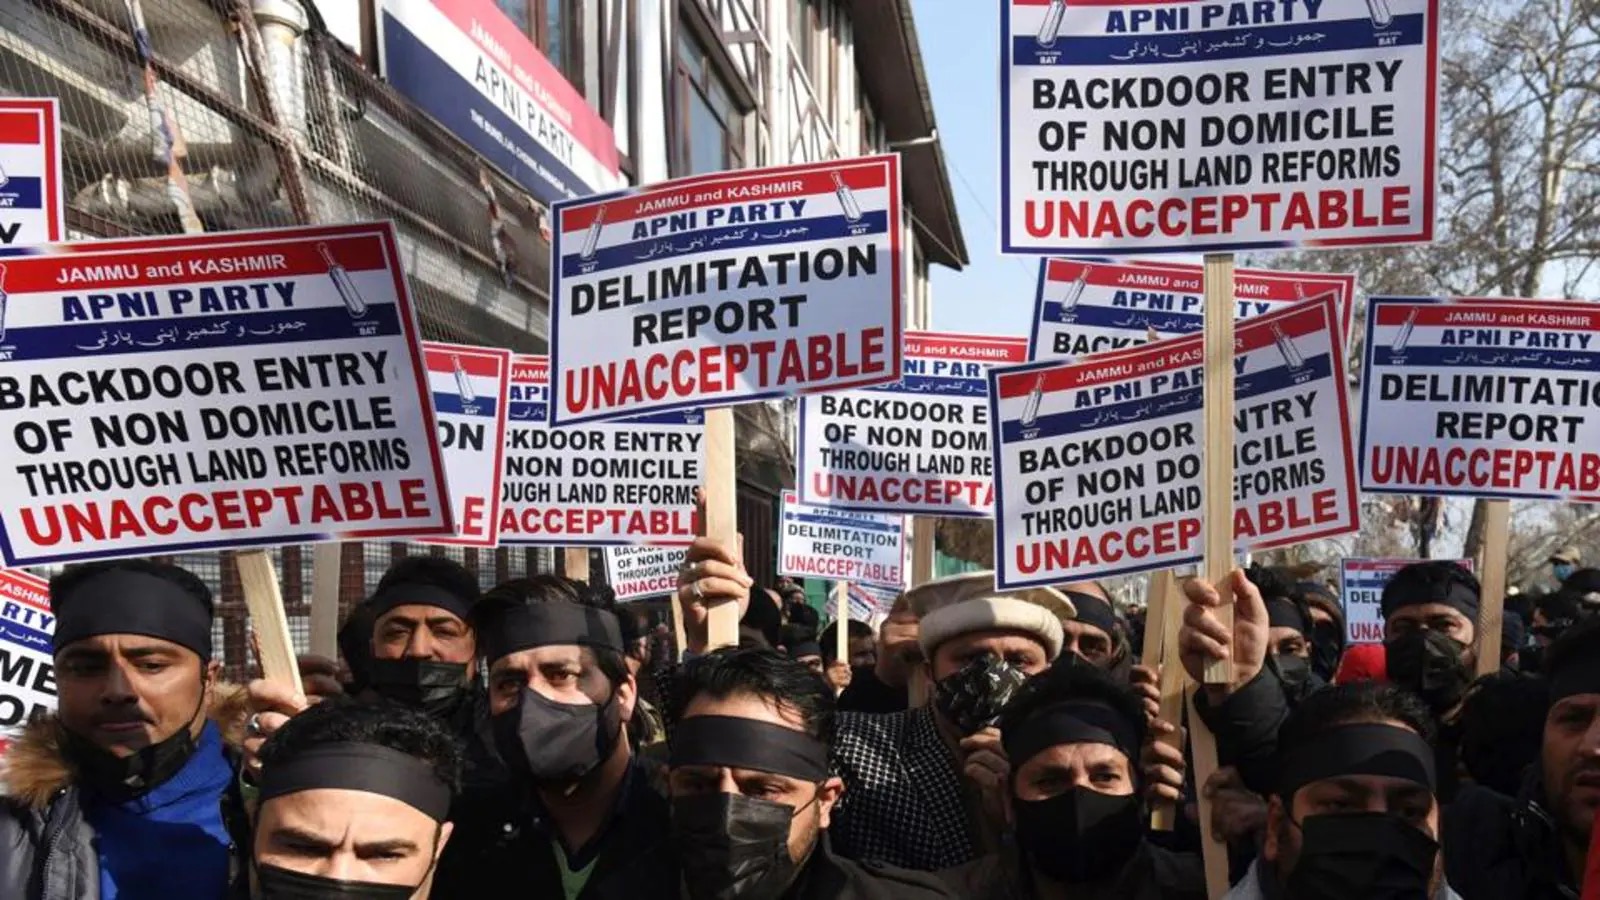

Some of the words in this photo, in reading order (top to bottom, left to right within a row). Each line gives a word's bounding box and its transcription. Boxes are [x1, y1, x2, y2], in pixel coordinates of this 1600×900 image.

[1106, 7, 1189, 32] APNI
[1202, 0, 1321, 28] PARTY
[1040, 56, 1057, 64] BAT
[1032, 71, 1250, 109] BACKDOOR
[1264, 60, 1403, 100] ENTRY
[476, 56, 521, 121] APNI
[528, 101, 574, 167] PARTY
[1038, 121, 1087, 152] OF
[1103, 118, 1186, 151] NON
[1200, 104, 1395, 148] DOMICILE
[1032, 159, 1168, 191] THROUGH
[1178, 155, 1252, 190] LAND
[1261, 145, 1401, 184] REFORMS
[635, 194, 690, 214] JAMMU
[694, 189, 722, 203] and
[728, 180, 804, 198] KASHMIR
[632, 211, 697, 240] APNI
[706, 200, 807, 227] PARTY
[1025, 186, 1411, 239] UNACCEPTABLE
[57, 263, 139, 284] JAMMU
[146, 260, 183, 278] and
[189, 254, 287, 275] KASHMIR
[570, 244, 878, 316] DELIMITATION
[1118, 273, 1170, 286] JAMMU
[1173, 278, 1200, 290] and
[62, 290, 158, 321] APNI
[168, 281, 296, 318] PARTY
[1112, 290, 1174, 310] APNI
[360, 326, 376, 336] BAT
[632, 294, 808, 348] REPORT
[1444, 312, 1496, 323] JAMMU
[1500, 313, 1524, 324] and
[1528, 314, 1590, 327] KASHMIR
[924, 344, 948, 354] and
[950, 345, 1009, 358] KASHMIR
[1441, 329, 1501, 345] APNI
[1509, 330, 1592, 349] PARTY
[0, 361, 246, 410] BACKDOOR
[253, 350, 388, 392] ENTRY
[511, 369, 548, 380] JAMM
[565, 327, 885, 414] UNACCEPTABLE
[904, 360, 926, 374] NI
[1076, 364, 1133, 382] JAMMU
[1136, 358, 1165, 373] and
[821, 395, 964, 424] BACKDOOR
[1075, 381, 1141, 409] APNI
[14, 419, 73, 456] OF
[90, 410, 191, 450] NON
[202, 396, 396, 442] DOMICILE
[824, 423, 857, 444] OF
[867, 426, 922, 448] NON
[1436, 411, 1584, 444] REPORT
[506, 429, 605, 452] KDOOR
[614, 432, 702, 454] ENTRY
[1019, 422, 1196, 474] BACKDOOR
[16, 453, 182, 497] THROUGH
[188, 443, 268, 484] LAND
[278, 438, 411, 478] REFORMS
[506, 456, 562, 478] NON
[572, 458, 698, 480] DOMICILE
[820, 448, 910, 472] THROUGH
[917, 453, 964, 475] LAND
[1371, 445, 1600, 492] UNACCEPTAB
[560, 483, 608, 504] LAND
[614, 484, 699, 506] REFORMS
[814, 472, 994, 506] UNACCEPT
[1025, 477, 1064, 506] OF
[1078, 464, 1144, 499] NON
[20, 479, 432, 548] UNACCEPTABLE
[1022, 497, 1132, 537] THROUGH
[1141, 485, 1202, 519] LAND
[788, 524, 898, 547] DELIMITATION
[1016, 490, 1338, 574] UNACCEPABLE
[618, 558, 632, 569] OF
[638, 553, 664, 566] NON
[812, 541, 874, 559] REPORT
[618, 567, 661, 580] THROUGH
[662, 563, 680, 574] LAN
[786, 555, 898, 582] UNACCEPTABLE
[616, 576, 678, 596] UNACCE
[2, 601, 56, 631] RTY
